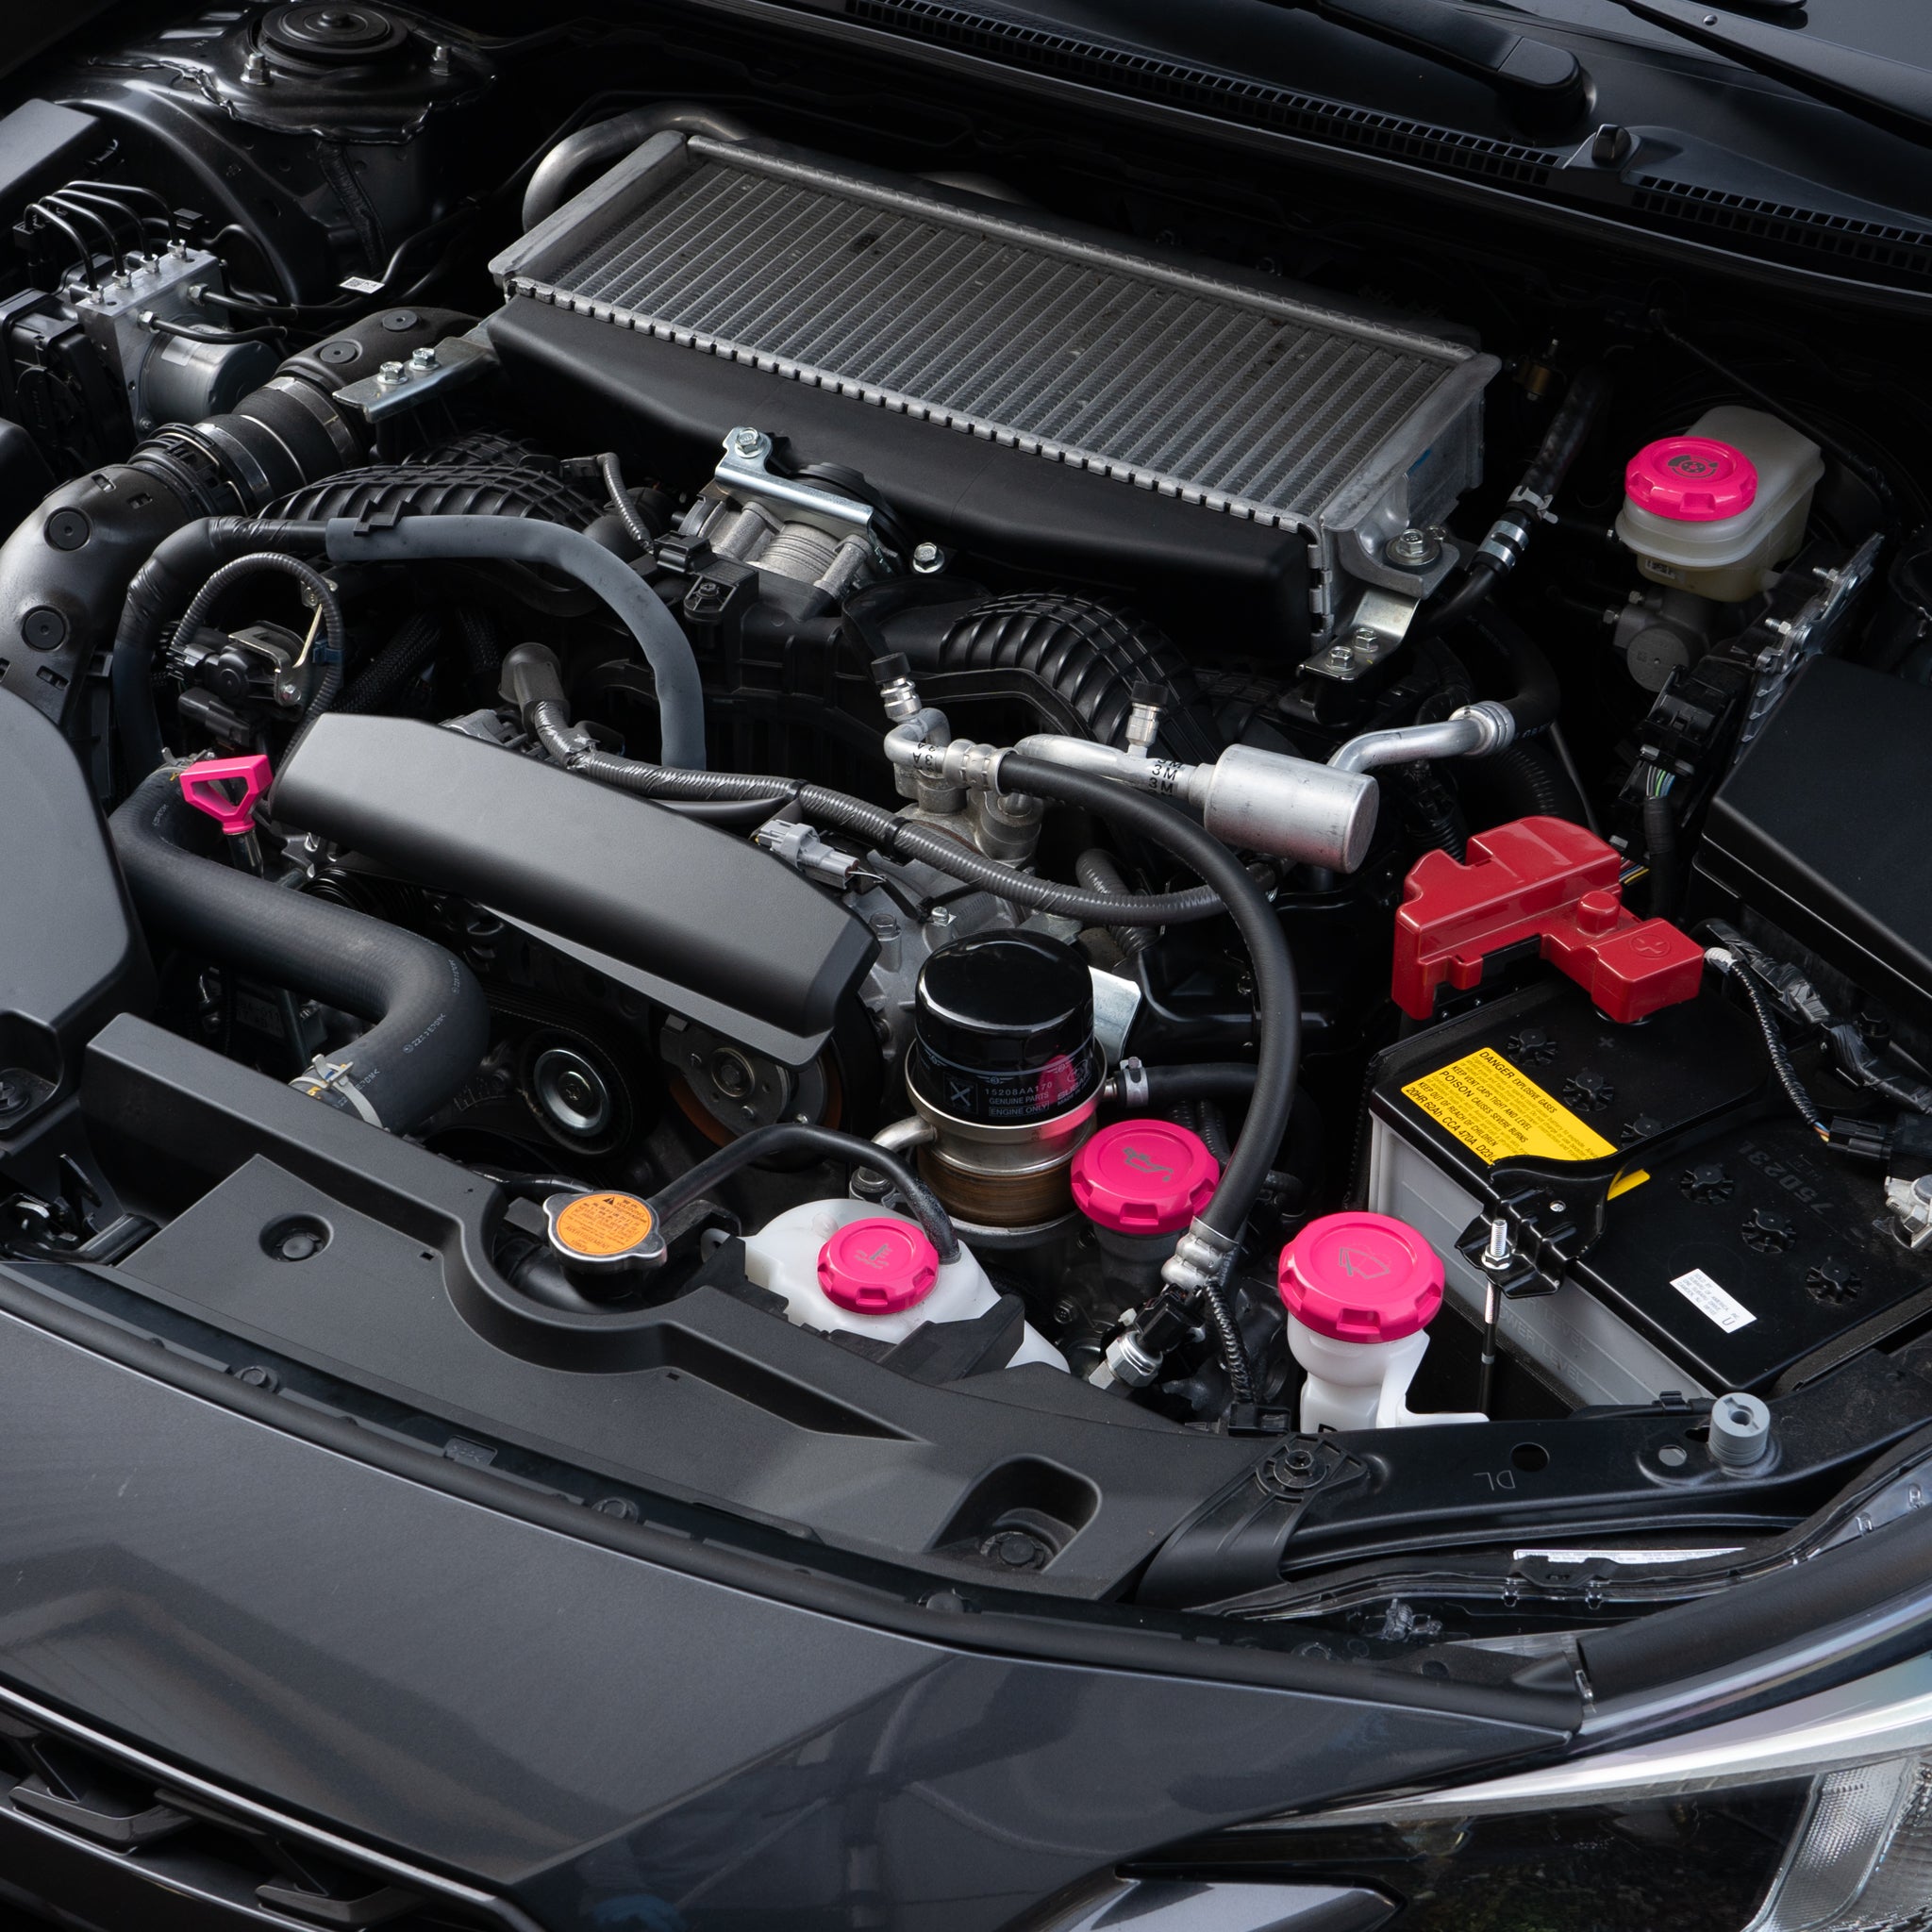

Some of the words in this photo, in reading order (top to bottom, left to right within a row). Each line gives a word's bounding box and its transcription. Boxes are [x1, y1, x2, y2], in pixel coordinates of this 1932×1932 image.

[1151, 763, 1177, 780] 3M
[1147, 776, 1174, 793] 3M
[985, 1082, 1053, 1095] 15208AA170
[1478, 1051, 1515, 1078] DANGER
[1511, 1077, 1541, 1100] EXPLOSIVE
[1538, 1098, 1557, 1113] GASES
[989, 1096, 1024, 1106] GENUINE
[1025, 1091, 1049, 1104] PARTS
[1439, 1070, 1474, 1097] POISON
[1471, 1096, 1493, 1114] CAUSES
[1490, 1112, 1511, 1128] SEVERE
[1507, 1126, 1528, 1142] BURNS
[1450, 1065, 1467, 1075] KEEP
[1463, 1074, 1480, 1087] VENT
[1475, 1085, 1492, 1098] CAPS
[1489, 1095, 1507, 1109] TIGHT
[1503, 1108, 1518, 1118] AND
[1514, 1116, 1532, 1131] LEVEL
[991, 1107, 1024, 1116] ENGINE
[1025, 1103, 1048, 1115] ONLY
[1405, 1087, 1428, 1104] 20HR
[1423, 1101, 1442, 1117] 62Ah
[1441, 1116, 1461, 1131] CCA
[1457, 1129, 1477, 1145] 470A
[1417, 1081, 1434, 1092] KEEP
[1429, 1091, 1444, 1101] OUT
[1446, 1105, 1467, 1121] REACH
[1470, 1124, 1498, 1147] CHILDREN
[1722, 1316, 1736, 1325] U
[1541, 1343, 1584, 1388] LEVEL
[1474, 1471, 1516, 1491] DL
